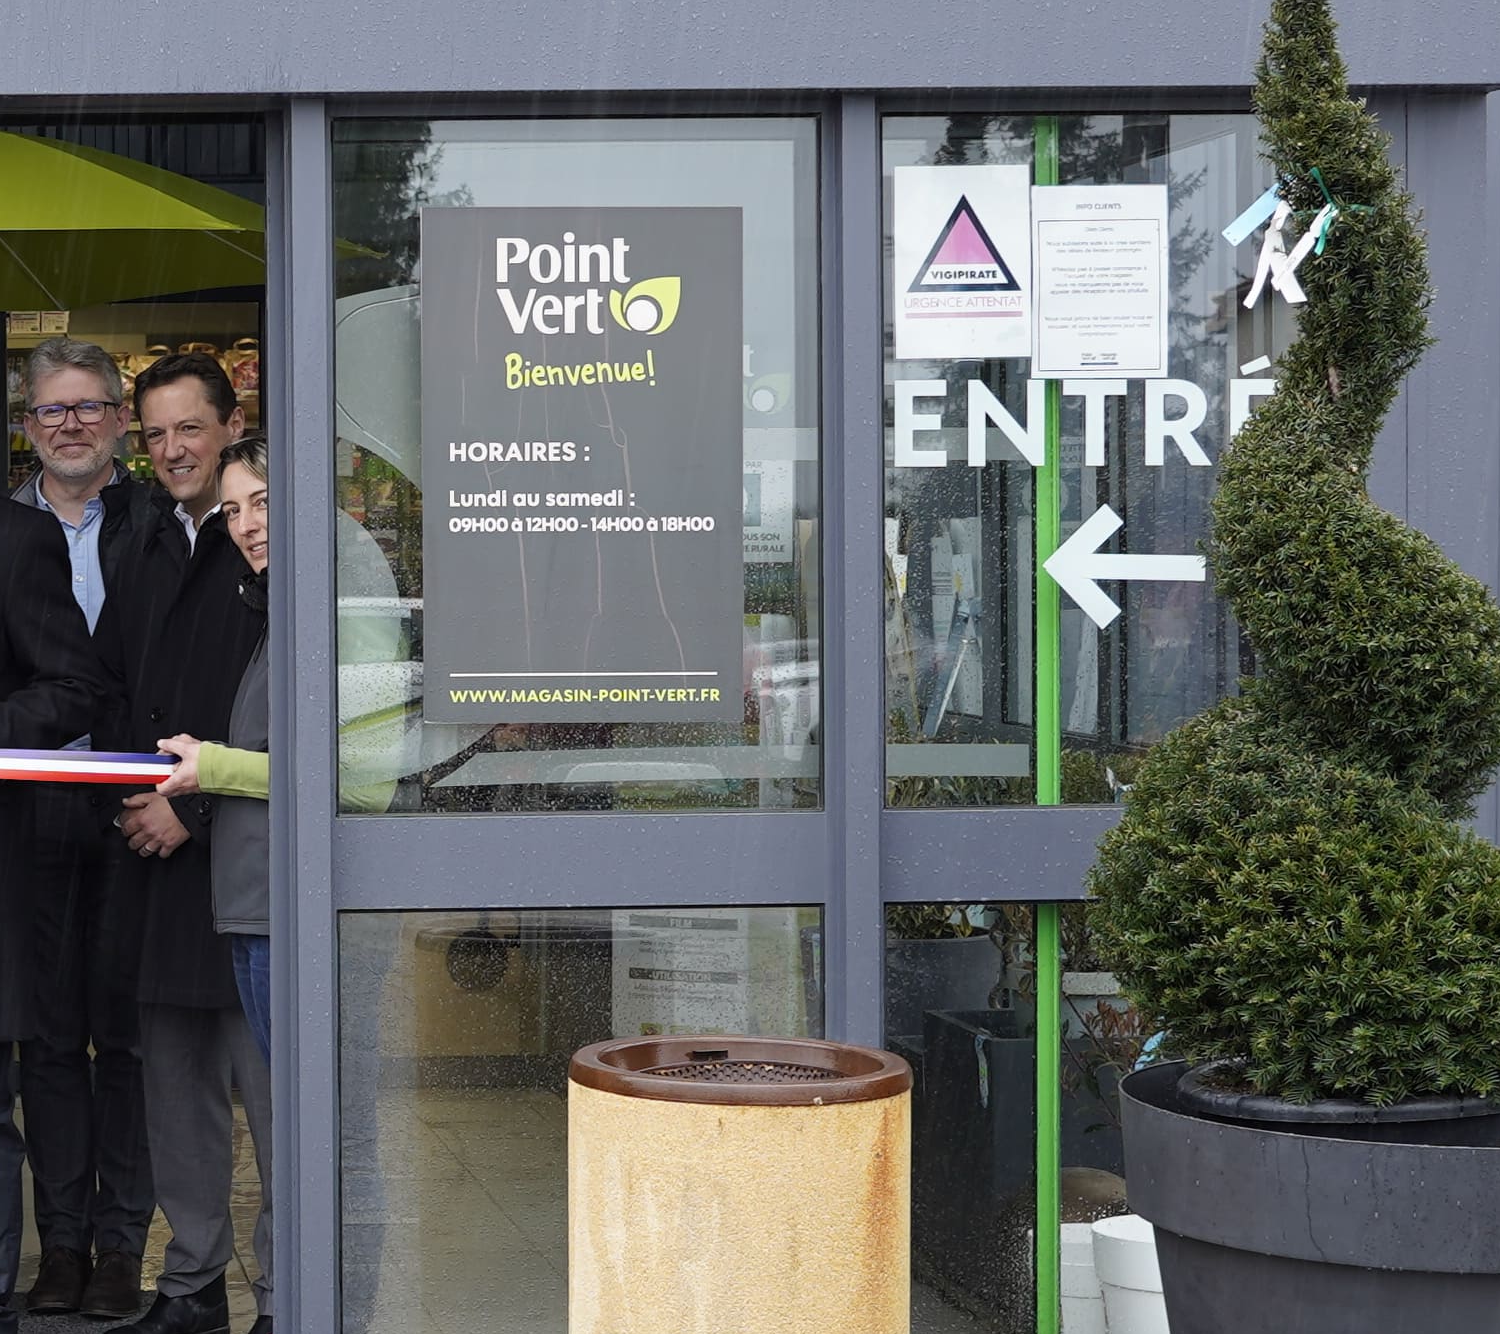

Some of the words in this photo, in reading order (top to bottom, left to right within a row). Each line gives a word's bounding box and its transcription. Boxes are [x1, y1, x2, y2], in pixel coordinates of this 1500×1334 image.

[496, 231, 631, 285] Point
[931, 269, 998, 281] VIGIPIRATE
[903, 295, 963, 309] URGENCE
[965, 294, 1022, 308] ATTENTAT
[496, 288, 605, 336] Vert
[505, 350, 656, 390] Bienvenue!
[894, 355, 1280, 467] ENTRÉ
[449, 441, 577, 462] HORAIRES
[449, 490, 507, 508] Lundi
[513, 494, 540, 508] au
[545, 490, 624, 508] samedi
[448, 517, 509, 533] 09H00
[511, 516, 524, 533] à
[526, 517, 579, 533] 12H00
[590, 517, 644, 533] 14H00
[646, 516, 659, 533] à
[661, 517, 715, 533] 18H00
[449, 687, 721, 703] WWW.MAGASIN-POINT-VERT.FR
